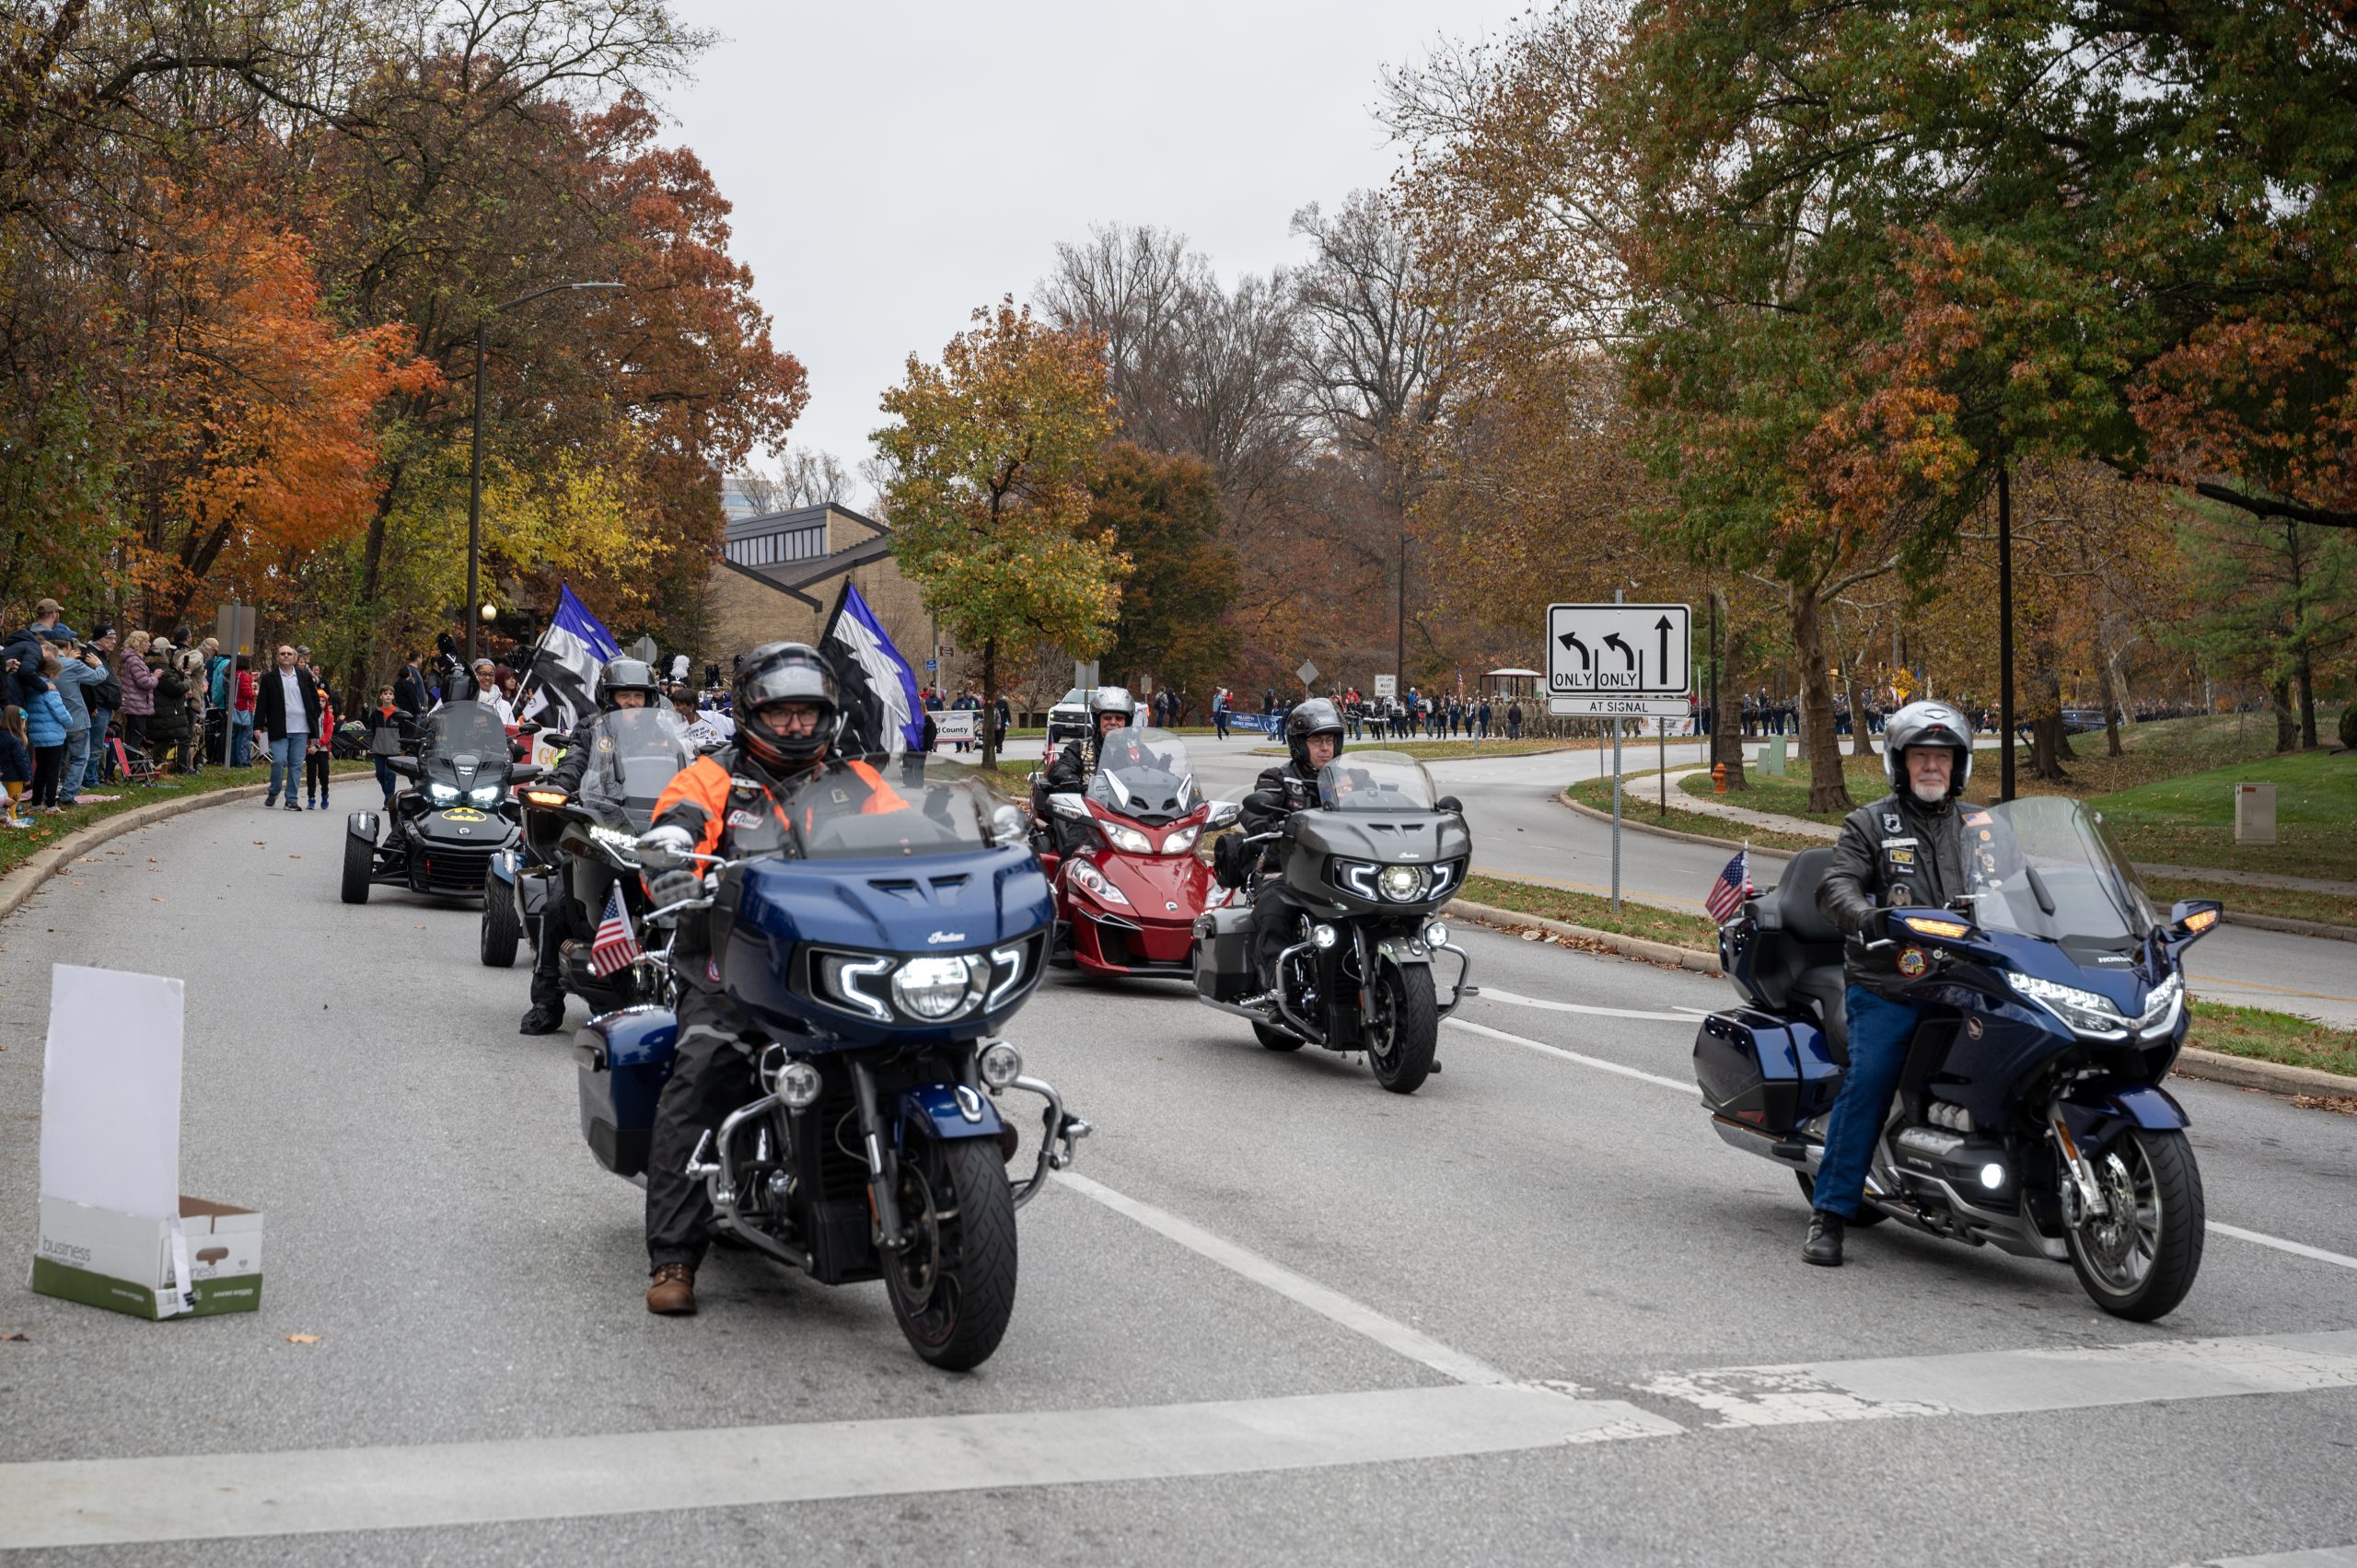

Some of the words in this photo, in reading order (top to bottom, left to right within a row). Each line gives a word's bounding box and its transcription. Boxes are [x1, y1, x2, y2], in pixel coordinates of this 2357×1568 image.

[1555, 673, 1592, 686] ONLY
[1600, 673, 1637, 686] ONLY
[1589, 702, 1603, 712] AT
[1607, 702, 1649, 713] SIGNAL
[942, 726, 968, 735] County
[927, 930, 966, 944] Indian
[42, 1235, 91, 1262] business
